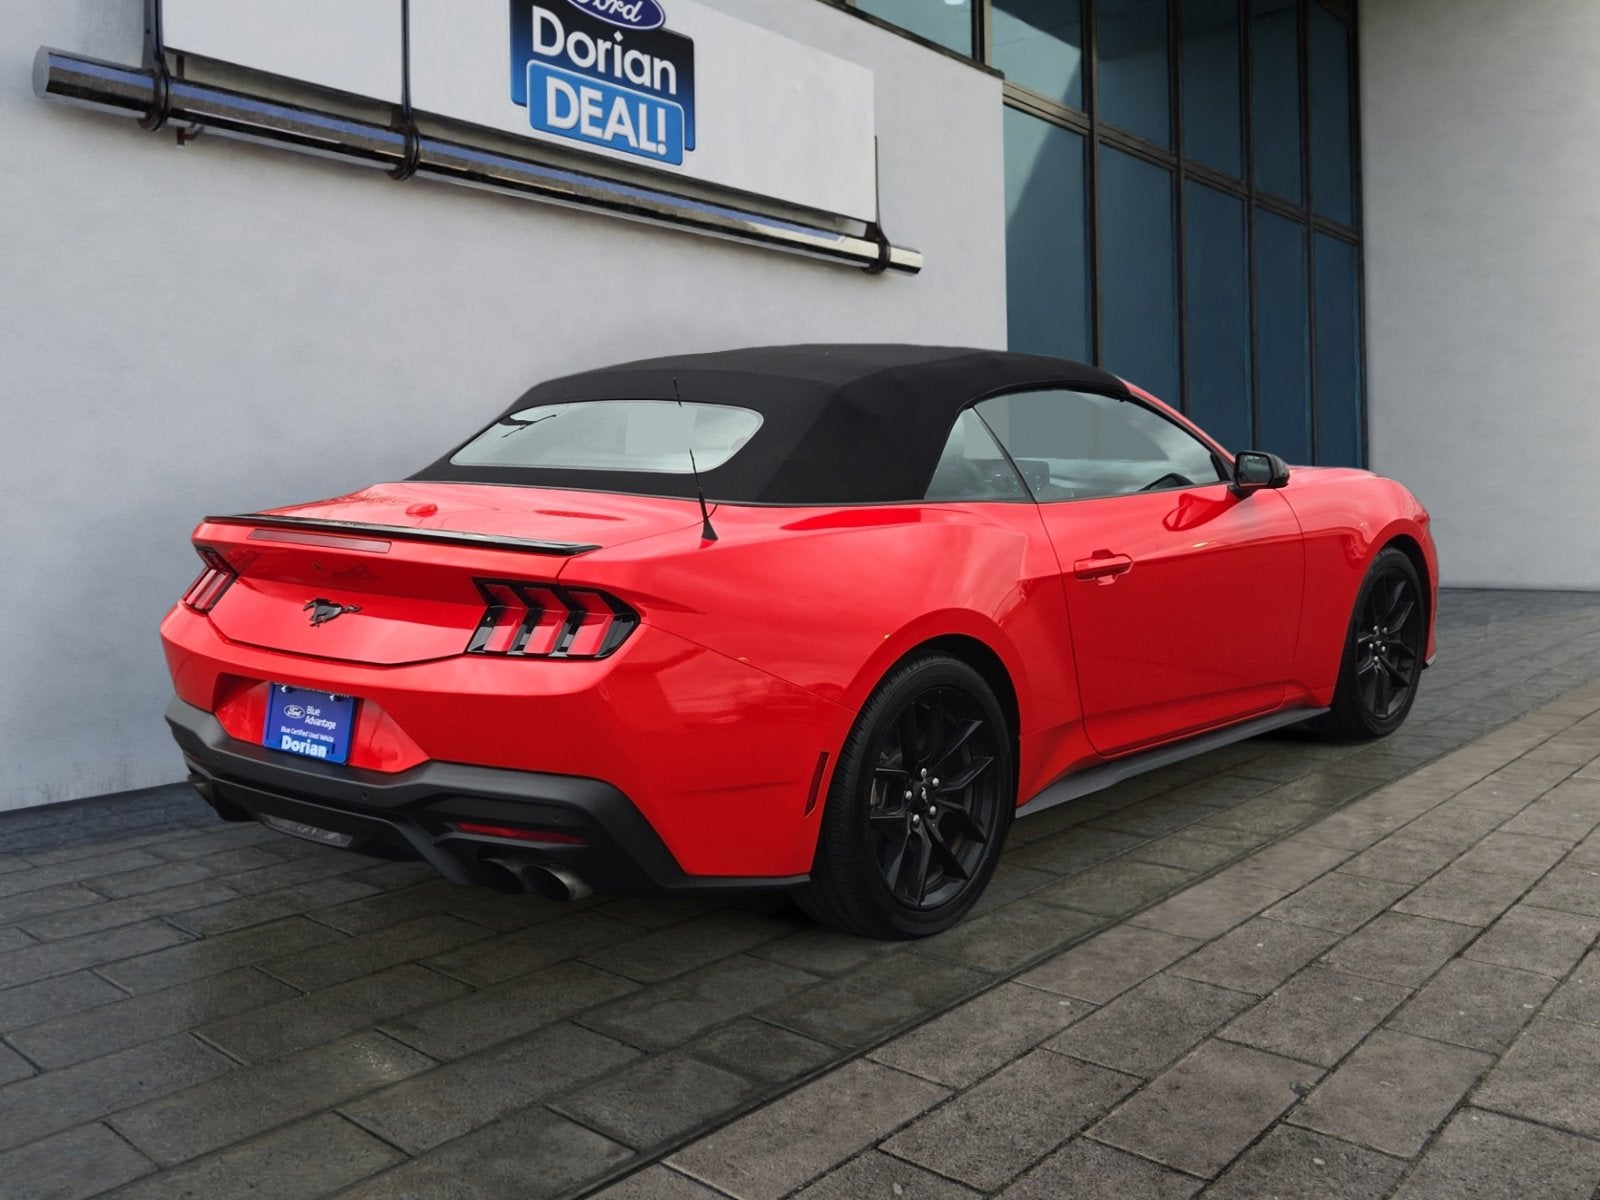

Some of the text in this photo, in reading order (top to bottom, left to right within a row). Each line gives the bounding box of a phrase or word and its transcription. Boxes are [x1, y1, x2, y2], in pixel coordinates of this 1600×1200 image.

[576, 0, 643, 22] ord
[532, 5, 676, 95] Dorian
[546, 75, 667, 156] DEAL!
[287, 706, 302, 717] Ford
[306, 705, 321, 716] Blue
[280, 726, 291, 734] Blue
[291, 728, 308, 737] Certified
[304, 716, 337, 730] Advantage
[281, 735, 327, 758] Dorian
